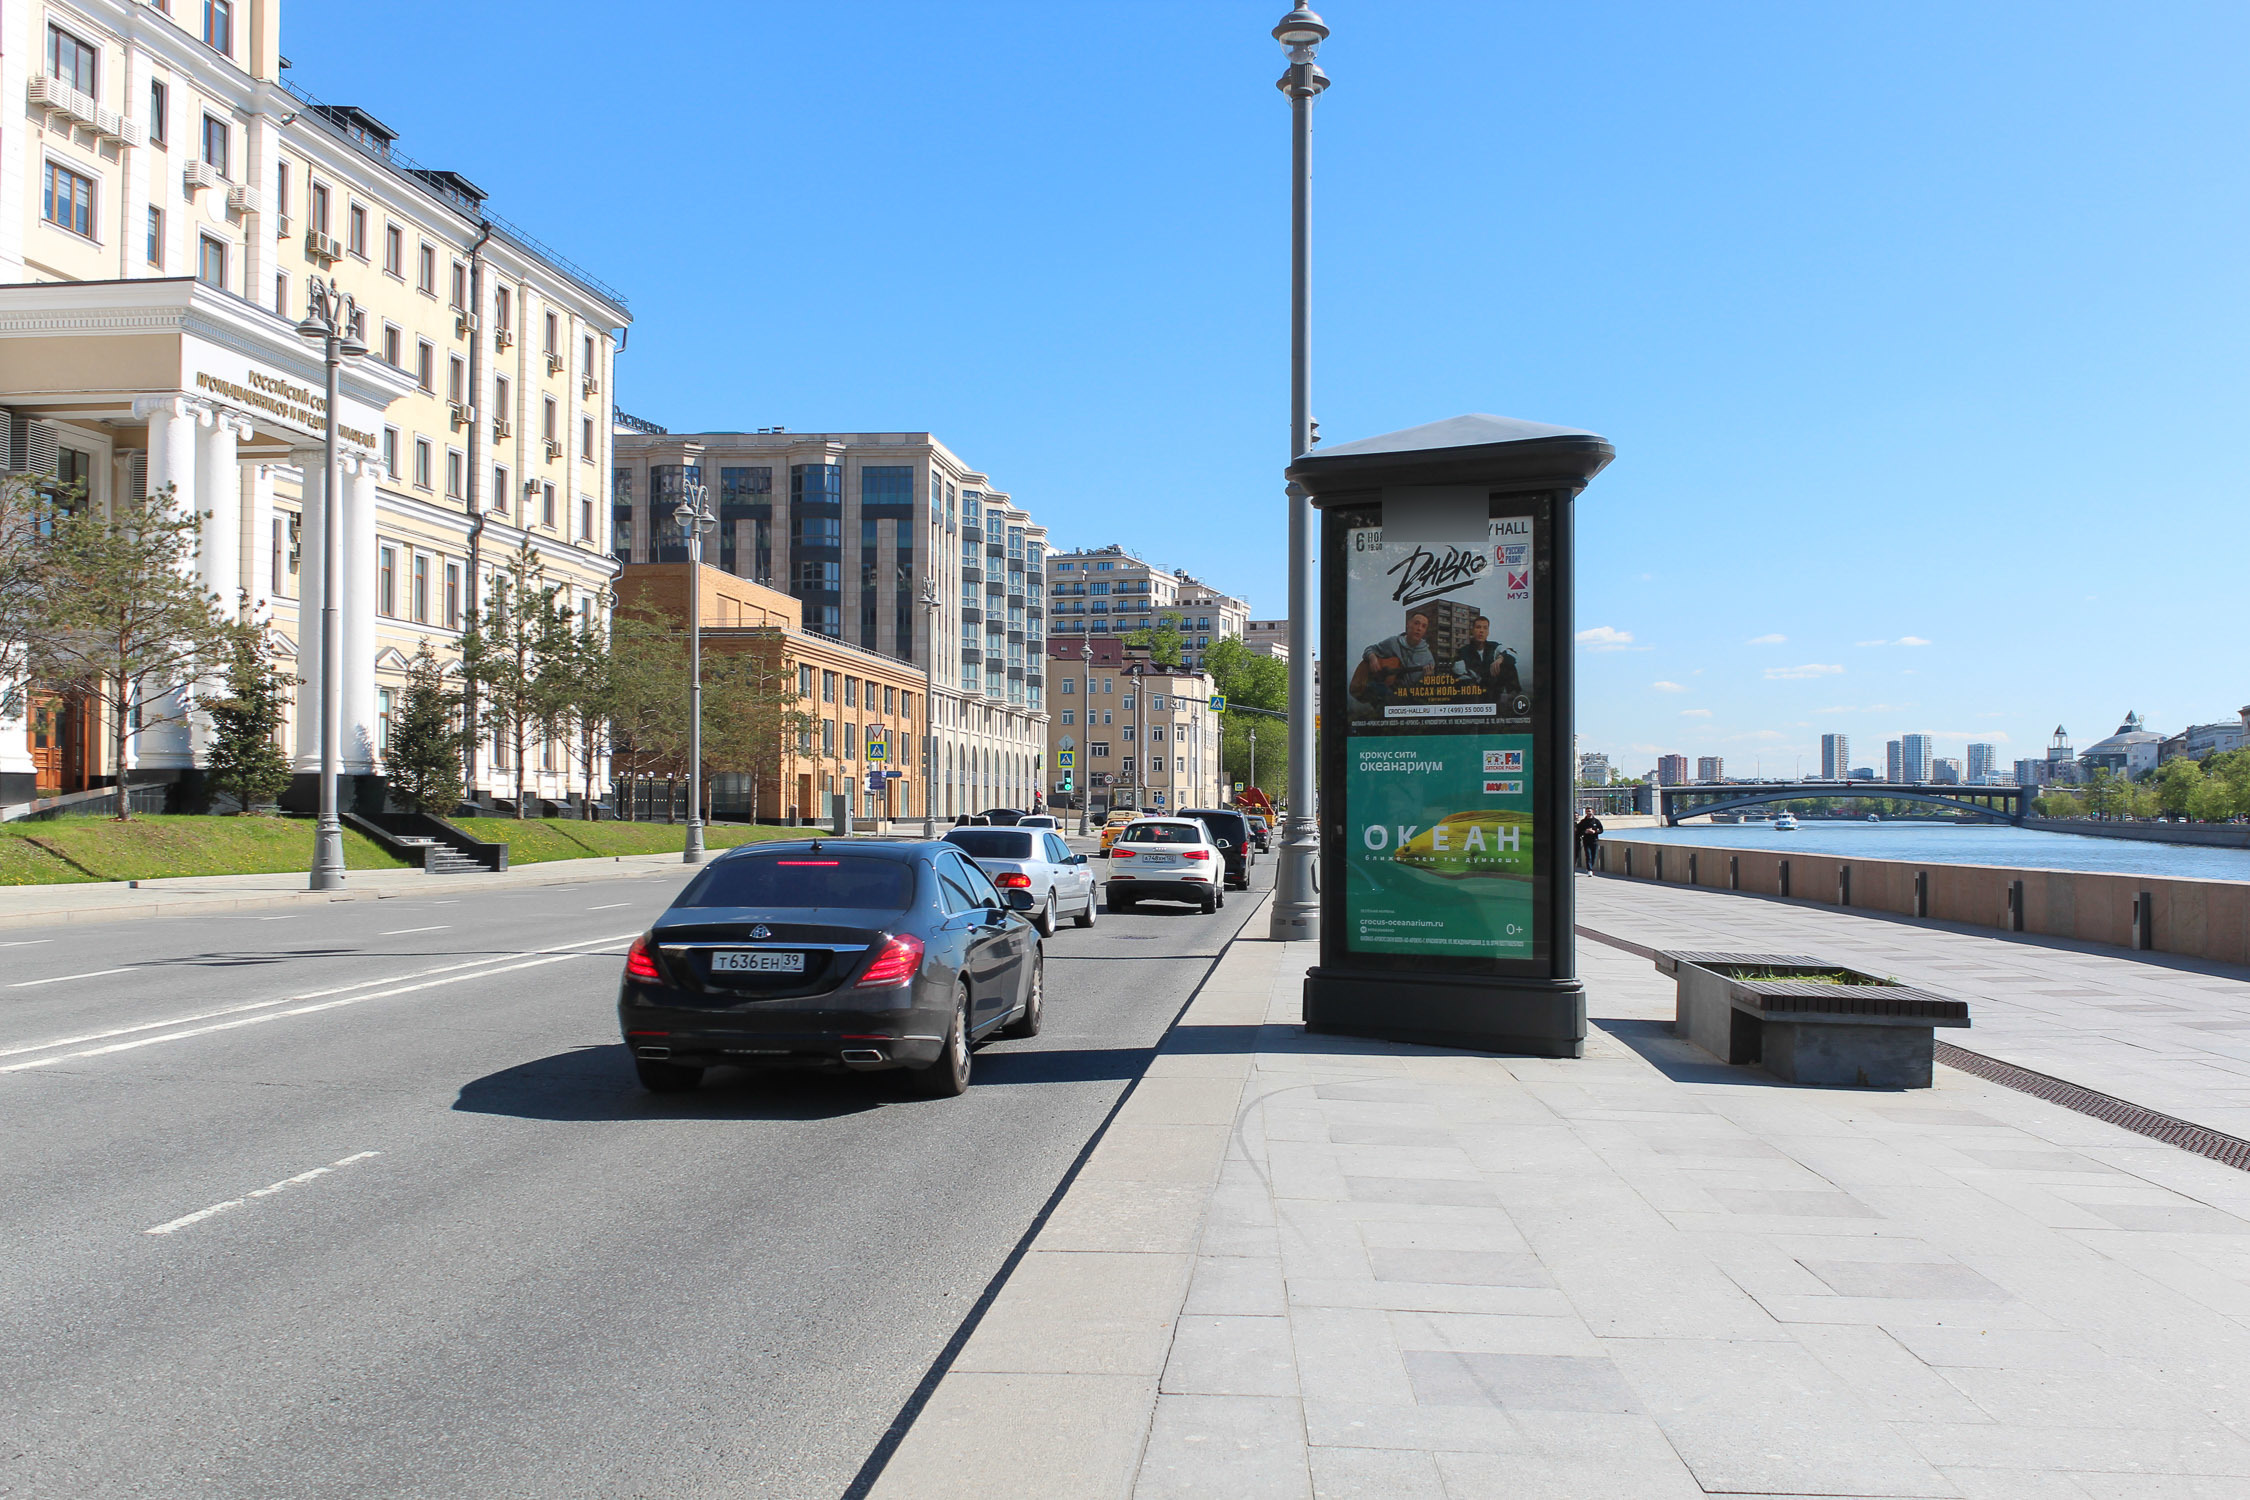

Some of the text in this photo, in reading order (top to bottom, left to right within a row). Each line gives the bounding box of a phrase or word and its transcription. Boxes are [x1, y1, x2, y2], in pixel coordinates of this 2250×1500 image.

[248, 370, 327, 411] РОССИЙСКИЙ СО
[196, 371, 376, 448] ПРОМЫШЛЕННИКОВ И ПРЕДПИМАТЕЛЕЙ
[614, 405, 668, 434] Ростелеком
[1495, 521, 1528, 535] HALL
[1356, 532, 1365, 552] 6
[1387, 545, 1488, 601] DABRO
[1507, 592, 1528, 600] МУЗ
[1409, 687, 1434, 697] ЧАСАХ
[1517, 701, 1526, 710] 0+
[1360, 751, 1417, 760] крокус сити
[1360, 760, 1443, 774] океанариум
[1364, 824, 1520, 851] ОКЕАН
[1365, 854, 1407, 862] ближе,
[1360, 919, 1444, 927] crocus-oceanarium.ru
[1506, 923, 1523, 935] 0+
[719, 954, 799, 969] Т636ЕН 39
